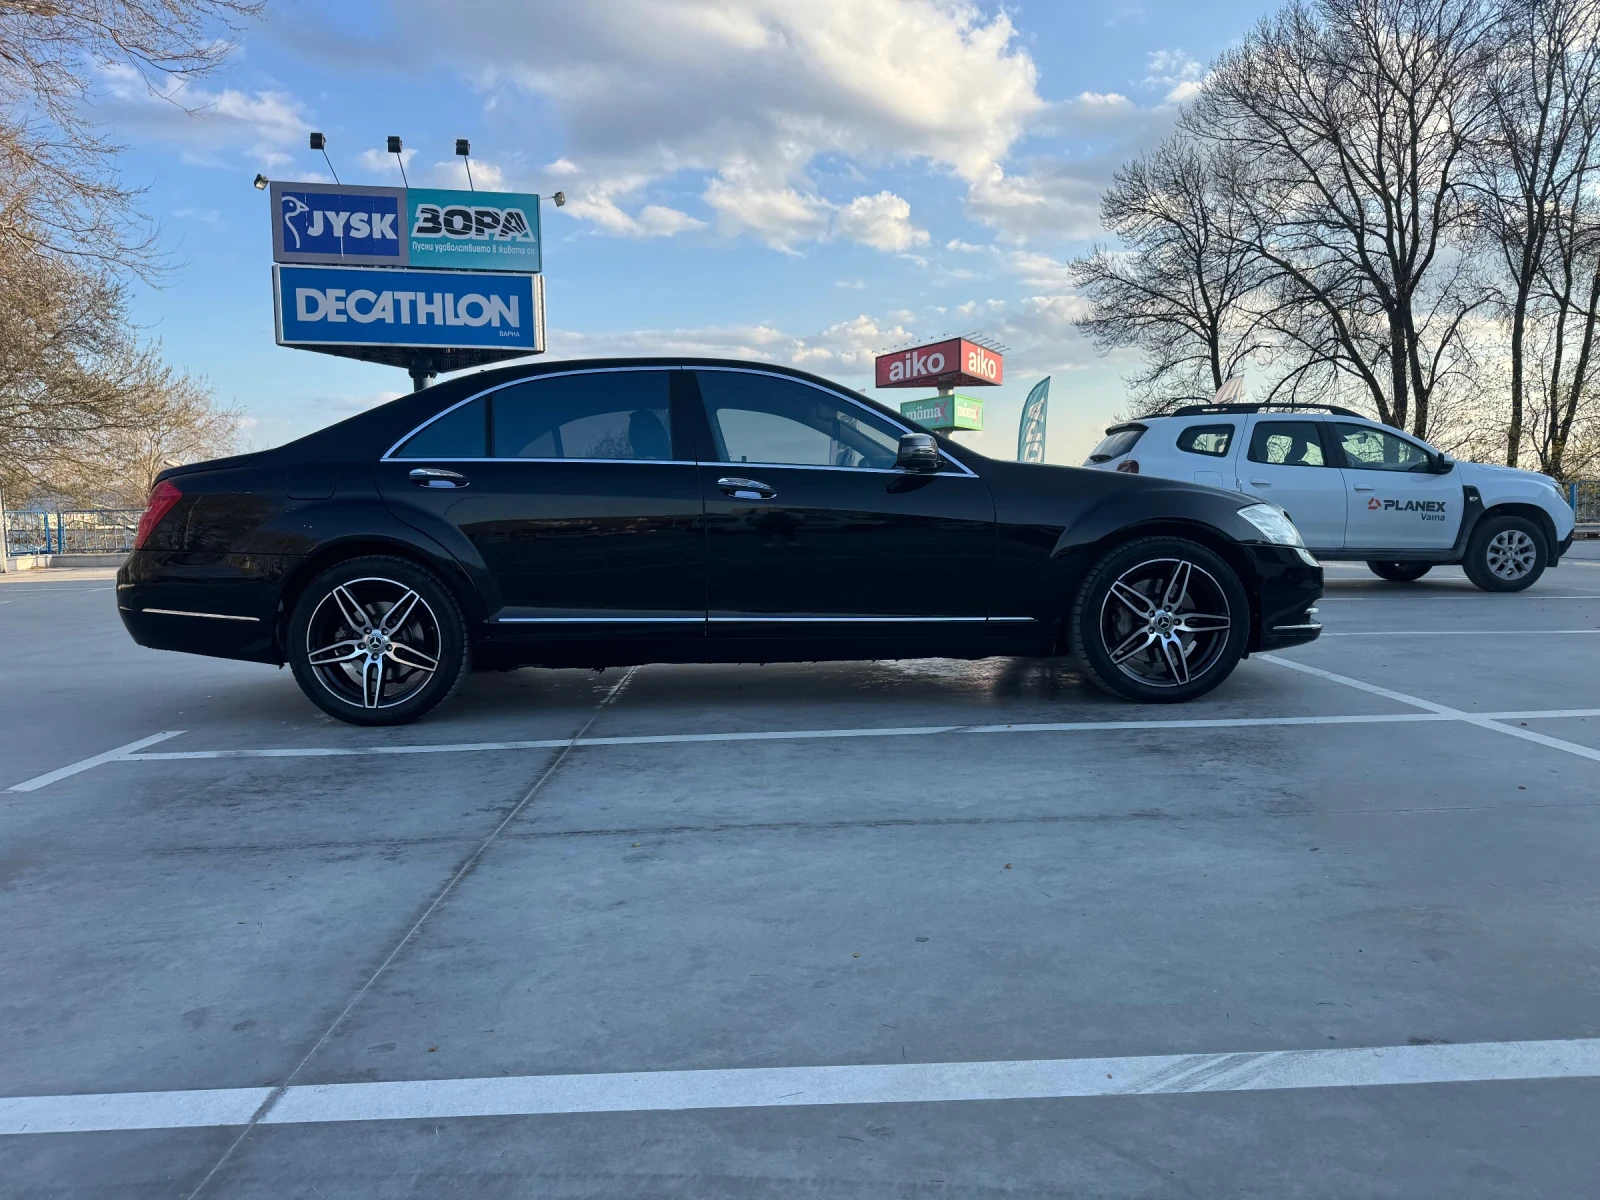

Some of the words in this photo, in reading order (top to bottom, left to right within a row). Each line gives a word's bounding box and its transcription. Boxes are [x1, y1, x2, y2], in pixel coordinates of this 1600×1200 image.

[306, 210, 398, 240] JYSK
[411, 204, 536, 242] ЗОРА
[412, 241, 434, 253] Пусни
[434, 243, 491, 254] удоволствието
[492, 244, 497, 252] в
[498, 245, 525, 255] живота
[526, 247, 536, 255] си
[295, 287, 520, 328] DECATHLON
[499, 330, 521, 338] ВАРНА
[889, 351, 946, 382] aiko
[968, 348, 997, 379] aiko
[1383, 499, 1447, 512] PLANEX
[1421, 512, 1446, 521] Varna
